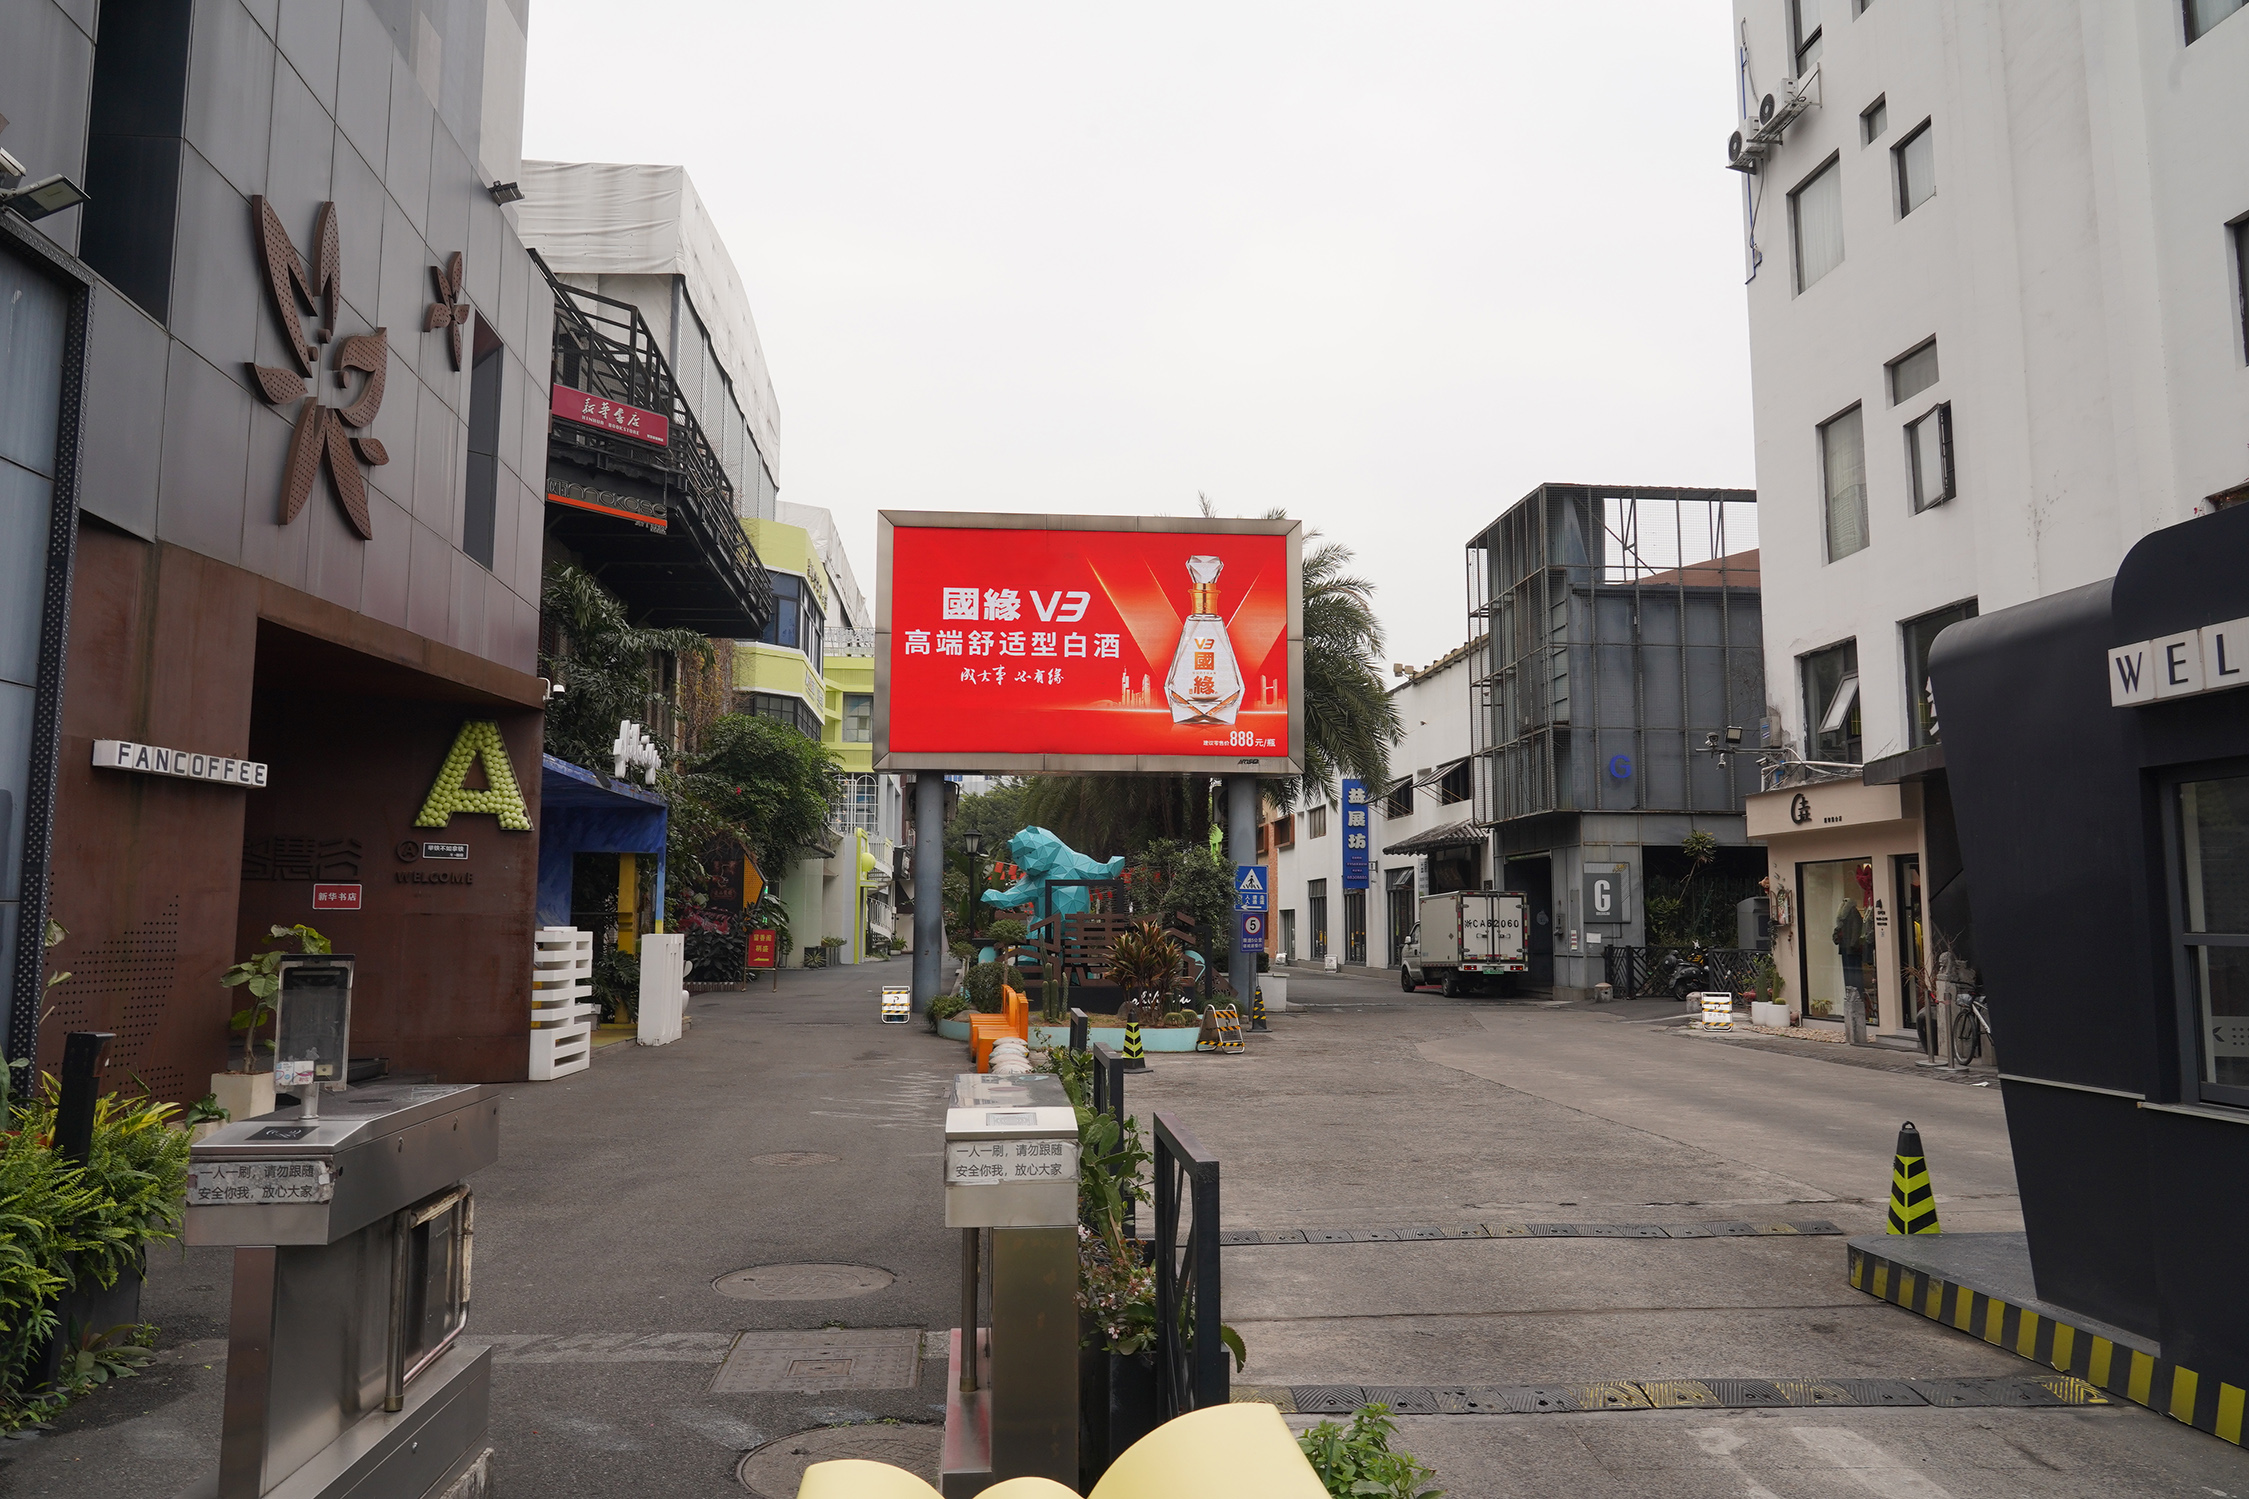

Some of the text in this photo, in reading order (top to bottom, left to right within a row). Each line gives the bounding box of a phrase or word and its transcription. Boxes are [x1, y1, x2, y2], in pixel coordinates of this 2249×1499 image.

[608, 422, 640, 436] BOOKSTORE
[1029, 590, 1091, 622] V3
[904, 629, 1121, 659] 高端舒适型白酒
[117, 743, 265, 785] FANCOFFEE
[1609, 754, 1632, 779] G
[412, 719, 534, 831] A
[394, 870, 474, 885] WELCOME
[318, 891, 357, 903] 新华书店
[1594, 879, 1611, 912] G
[1249, 919, 1257, 931] 5
[956, 1143, 1063, 1158] 一人一刷，请勿跟随
[200, 1164, 314, 1180] 一人一刷，请勿跟随
[955, 1162, 1062, 1178] 安全你我，放心大家
[198, 1184, 313, 1200] 安全你我，放心大家
